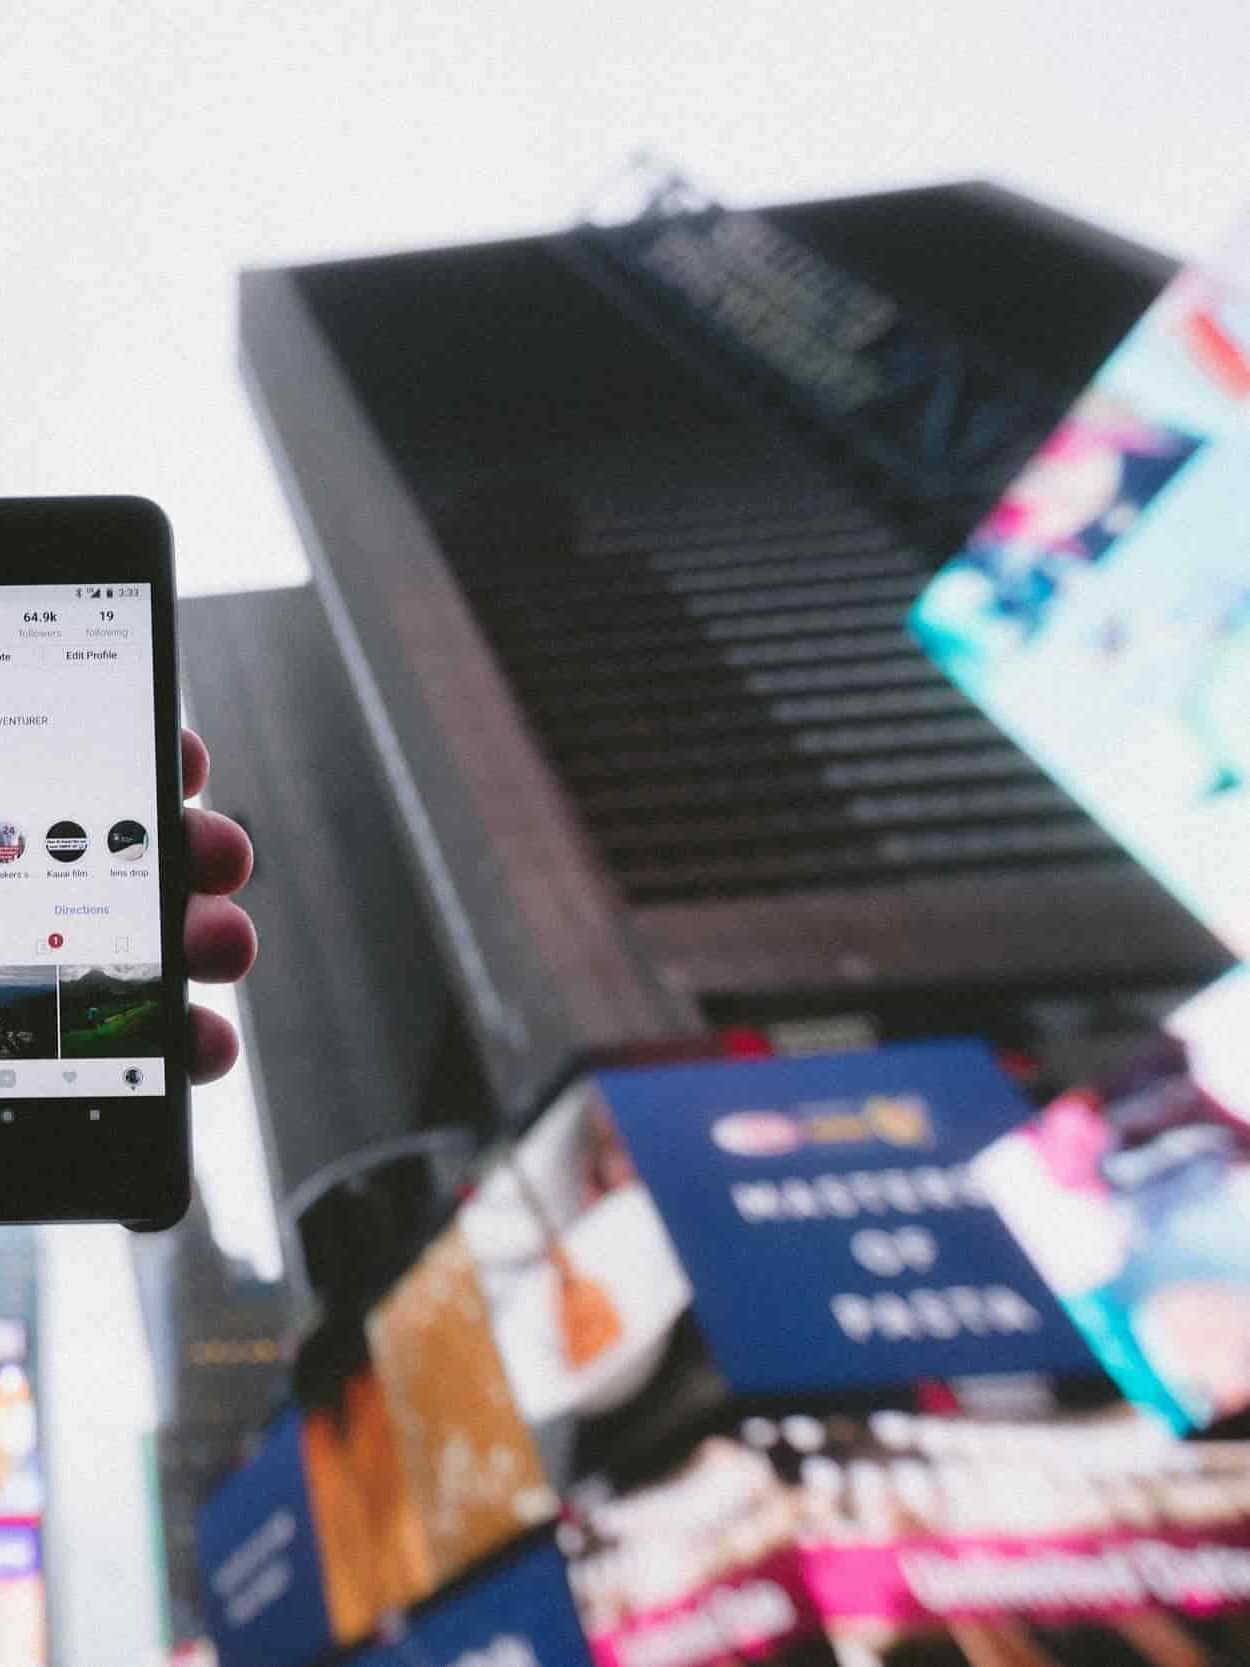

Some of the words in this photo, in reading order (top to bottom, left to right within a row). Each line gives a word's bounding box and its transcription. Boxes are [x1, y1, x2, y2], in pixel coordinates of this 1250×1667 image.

[118, 587, 139, 598] 3:33
[23, 611, 58, 623] 64.9k
[99, 610, 114, 622] 19
[18, 628, 62, 638] followers
[85, 628, 128, 639] following
[66, 650, 84, 661] Edit
[86, 649, 117, 660] Profile
[72, 868, 88, 877] film
[129, 868, 149, 879] drop
[54, 905, 110, 916] Directions
